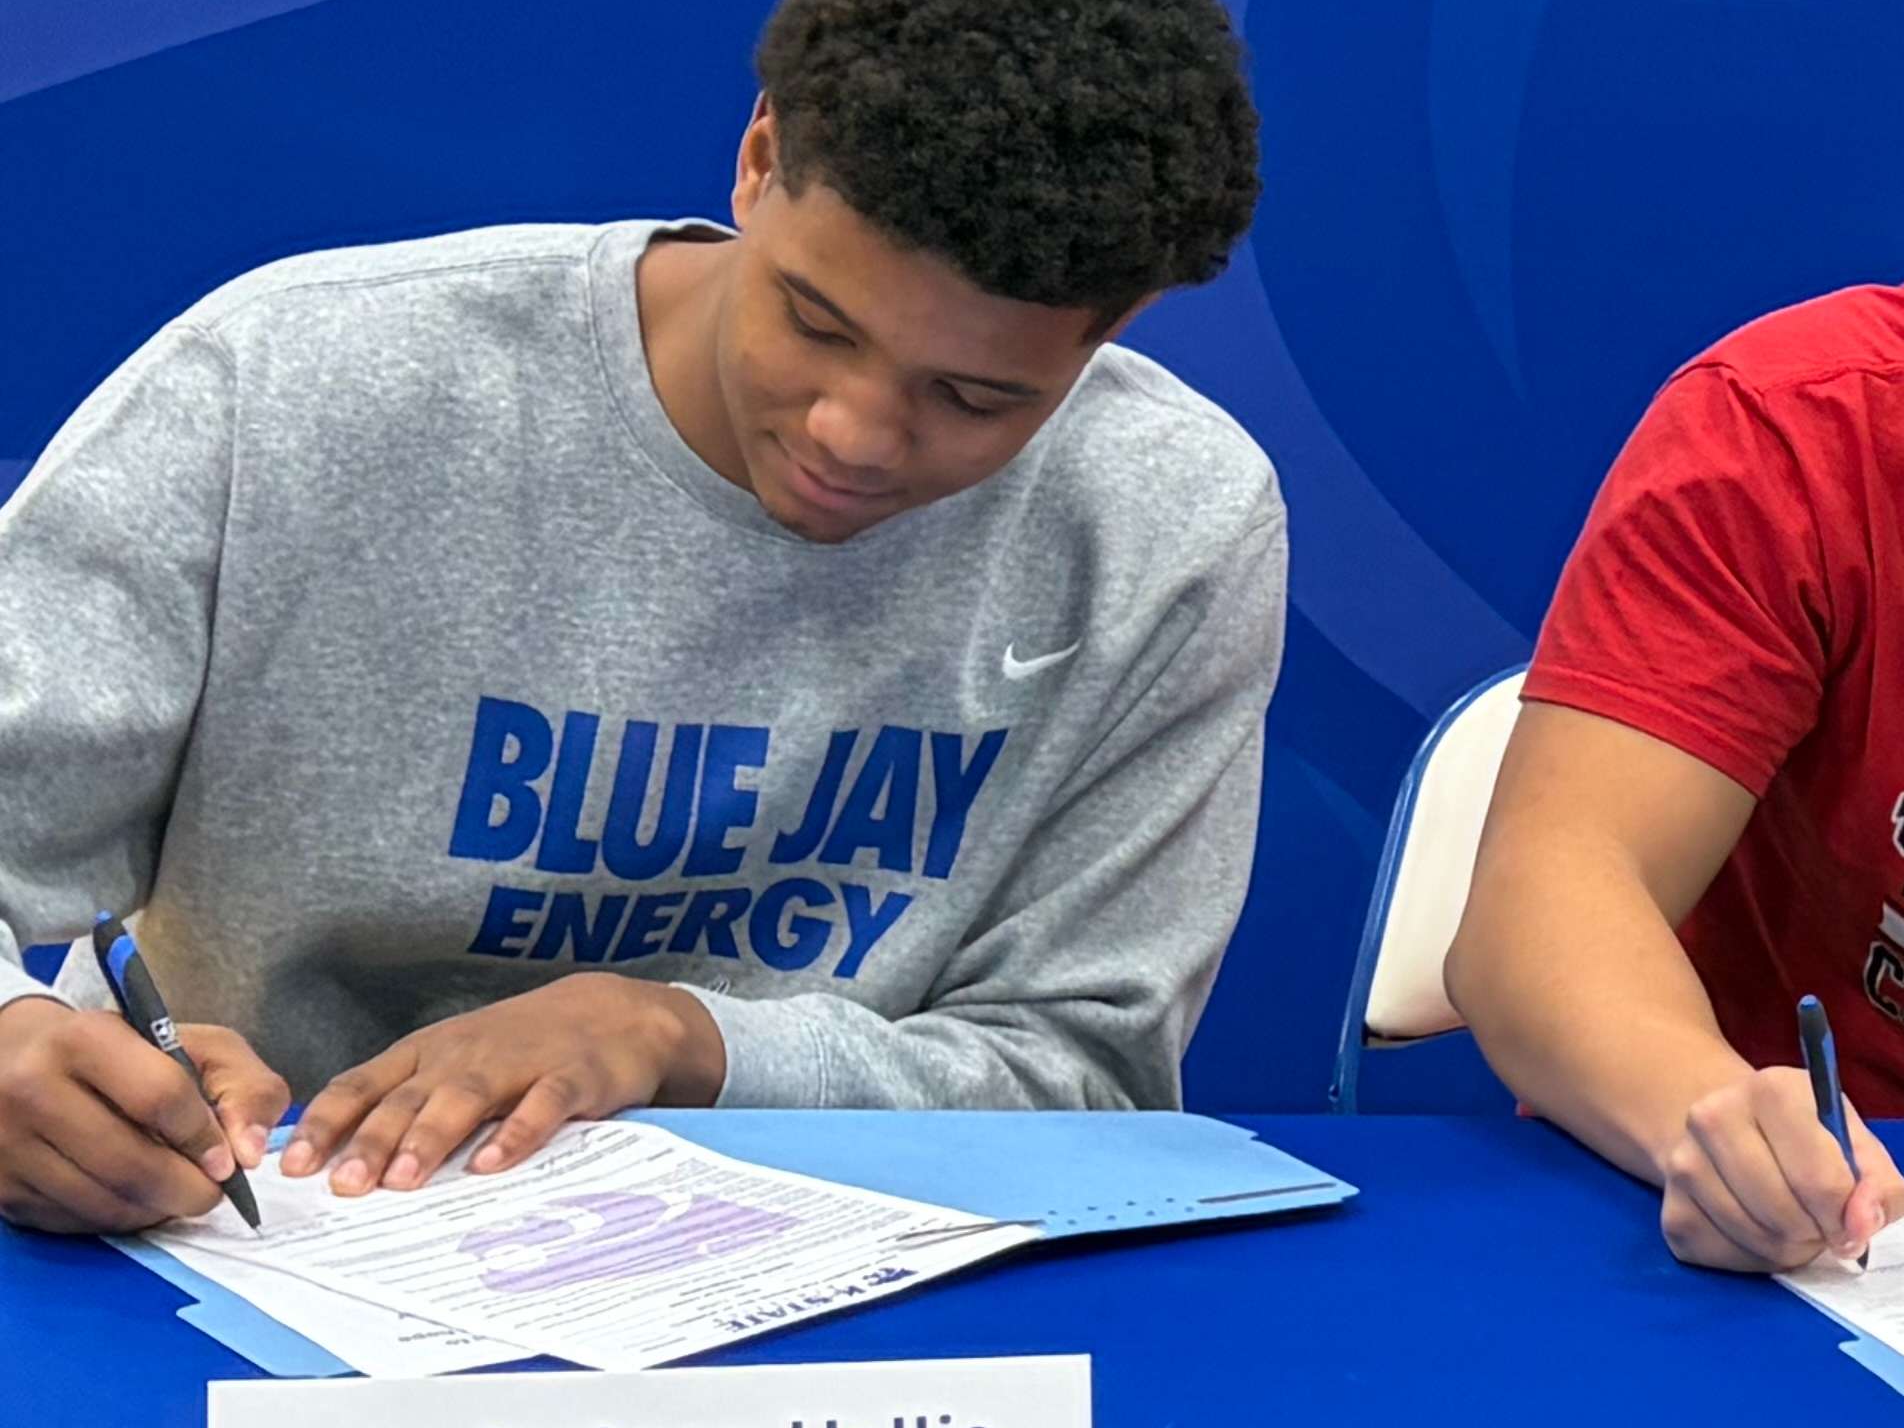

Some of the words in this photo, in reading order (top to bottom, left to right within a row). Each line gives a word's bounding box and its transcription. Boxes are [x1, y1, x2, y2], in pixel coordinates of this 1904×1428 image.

[448, 694, 771, 880] BLUE
[768, 724, 1009, 880] JAY
[466, 877, 913, 979] ENERGY
